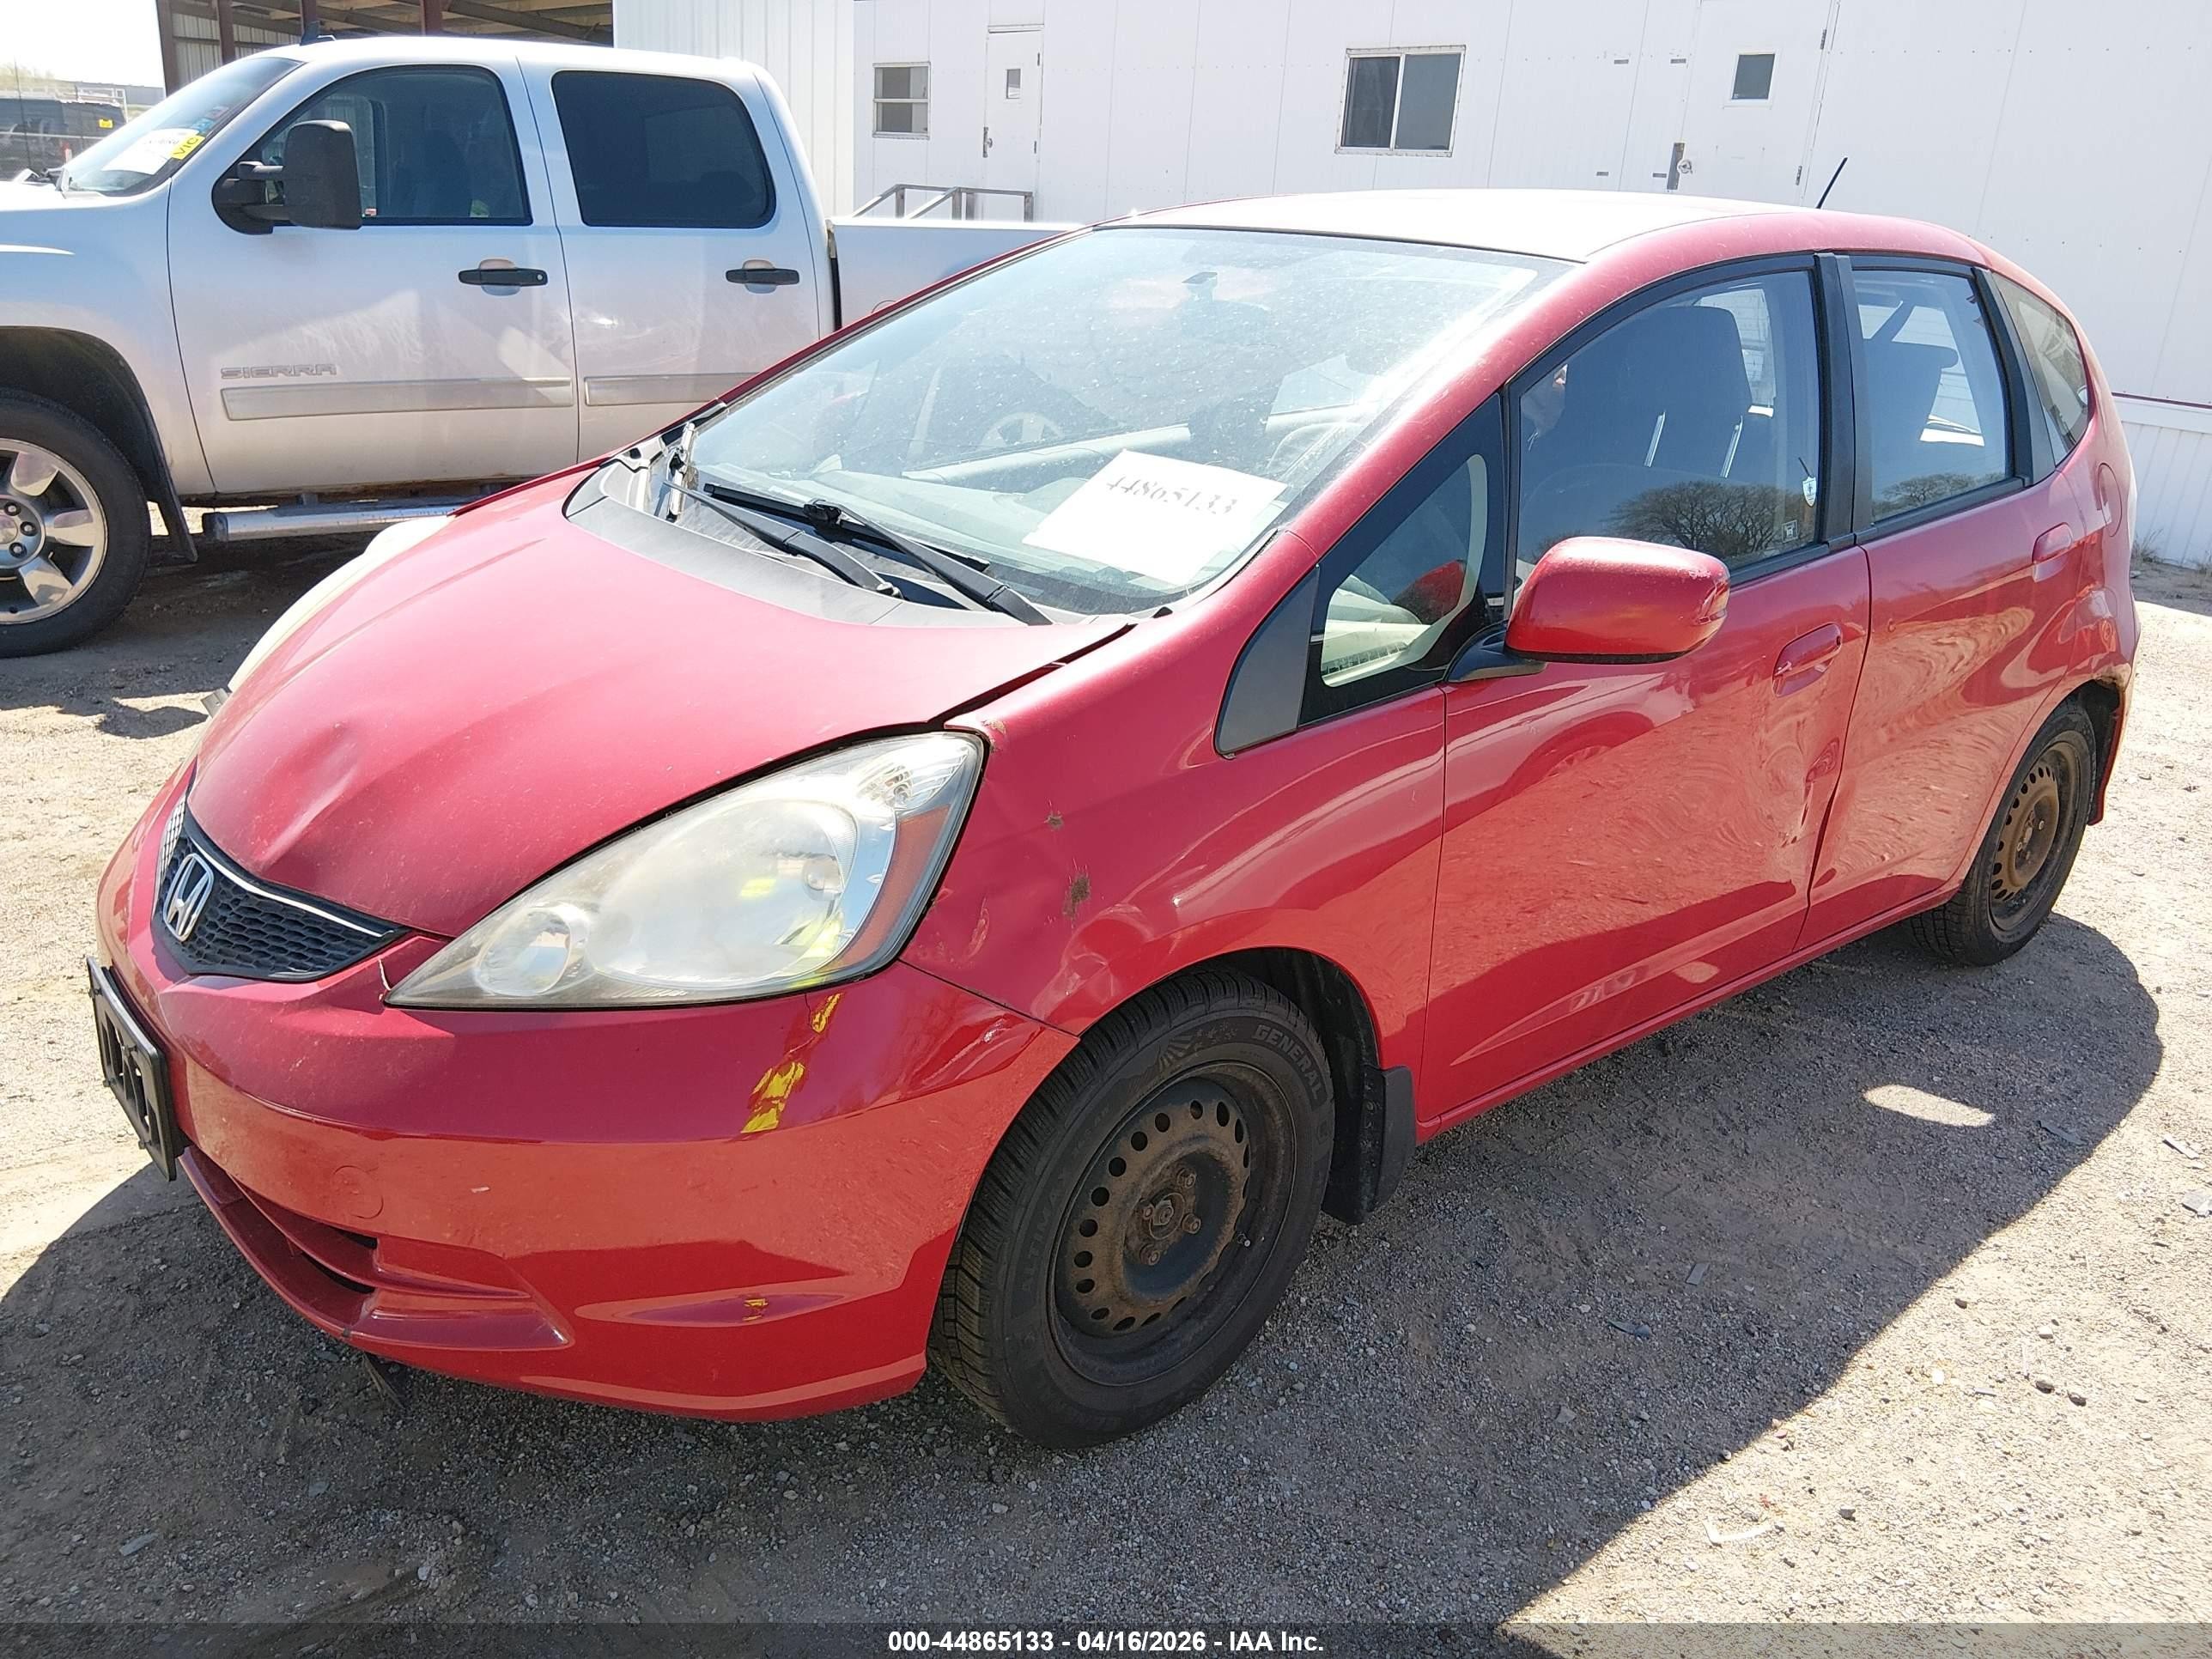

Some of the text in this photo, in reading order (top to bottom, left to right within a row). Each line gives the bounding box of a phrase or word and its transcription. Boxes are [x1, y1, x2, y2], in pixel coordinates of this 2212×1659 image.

[221, 364, 337, 380] SIERRA
[1106, 477, 1237, 514] 44865133
[1252, 1024, 1322, 1100] GENERAL
